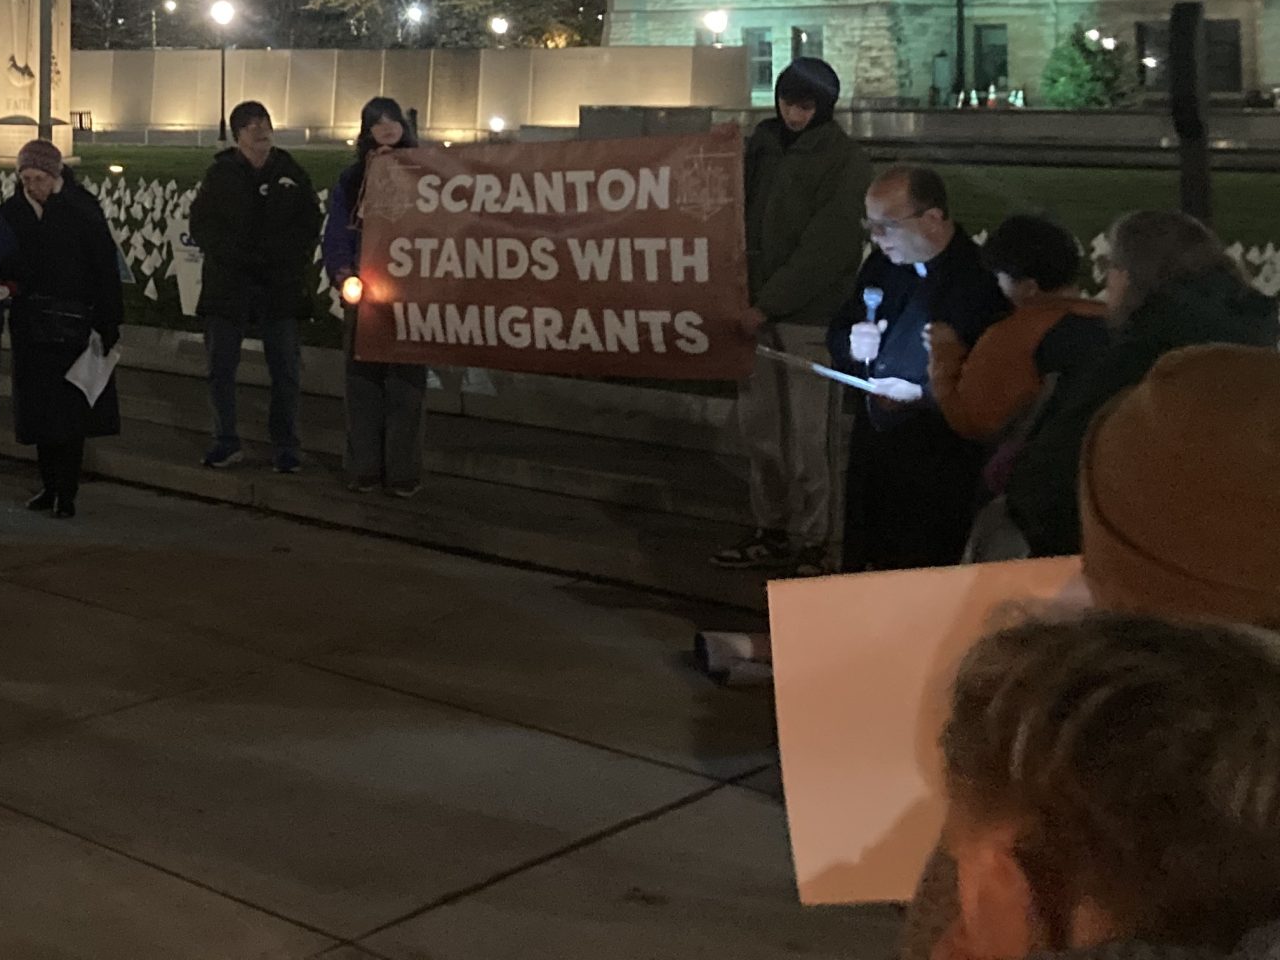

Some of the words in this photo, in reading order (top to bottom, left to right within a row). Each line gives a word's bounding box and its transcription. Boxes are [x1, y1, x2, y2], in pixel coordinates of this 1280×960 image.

[417, 166, 671, 214] SCRANTON
[387, 238, 560, 281] STANDS
[567, 238, 710, 283] WITH
[392, 302, 710, 355] IMMIGRANTS
